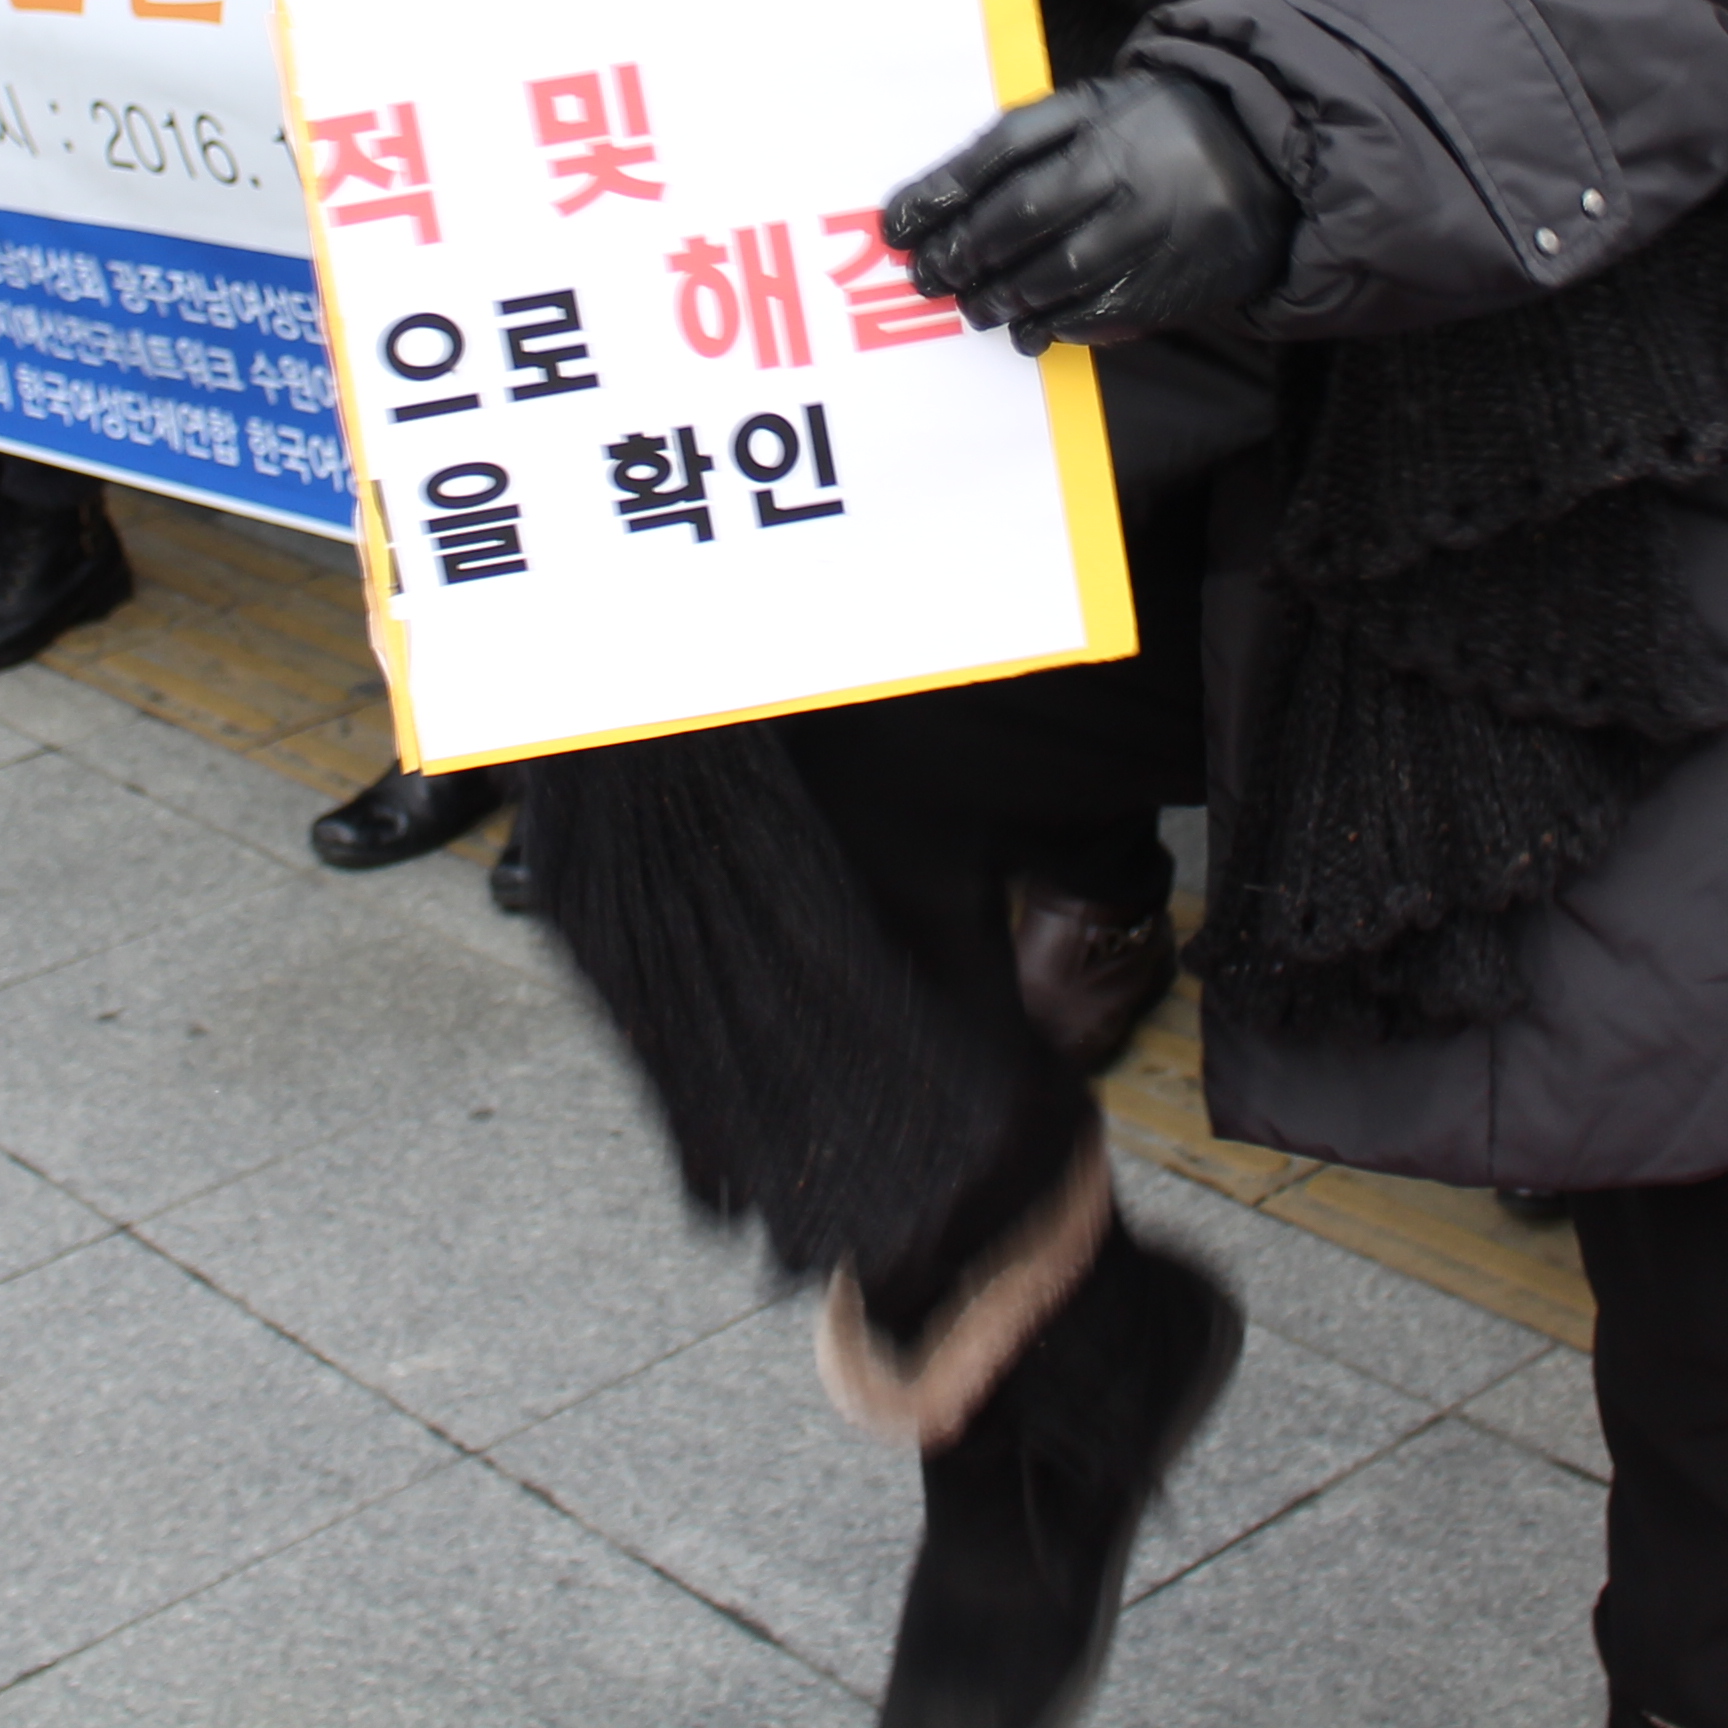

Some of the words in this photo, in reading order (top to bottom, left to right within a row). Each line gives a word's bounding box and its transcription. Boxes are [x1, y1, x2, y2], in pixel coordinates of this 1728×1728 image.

[523, 60, 667, 218] 및
[377, 286, 602, 425] 으로
[245, 415, 359, 496] 한국여
[601, 400, 849, 545] 확인
